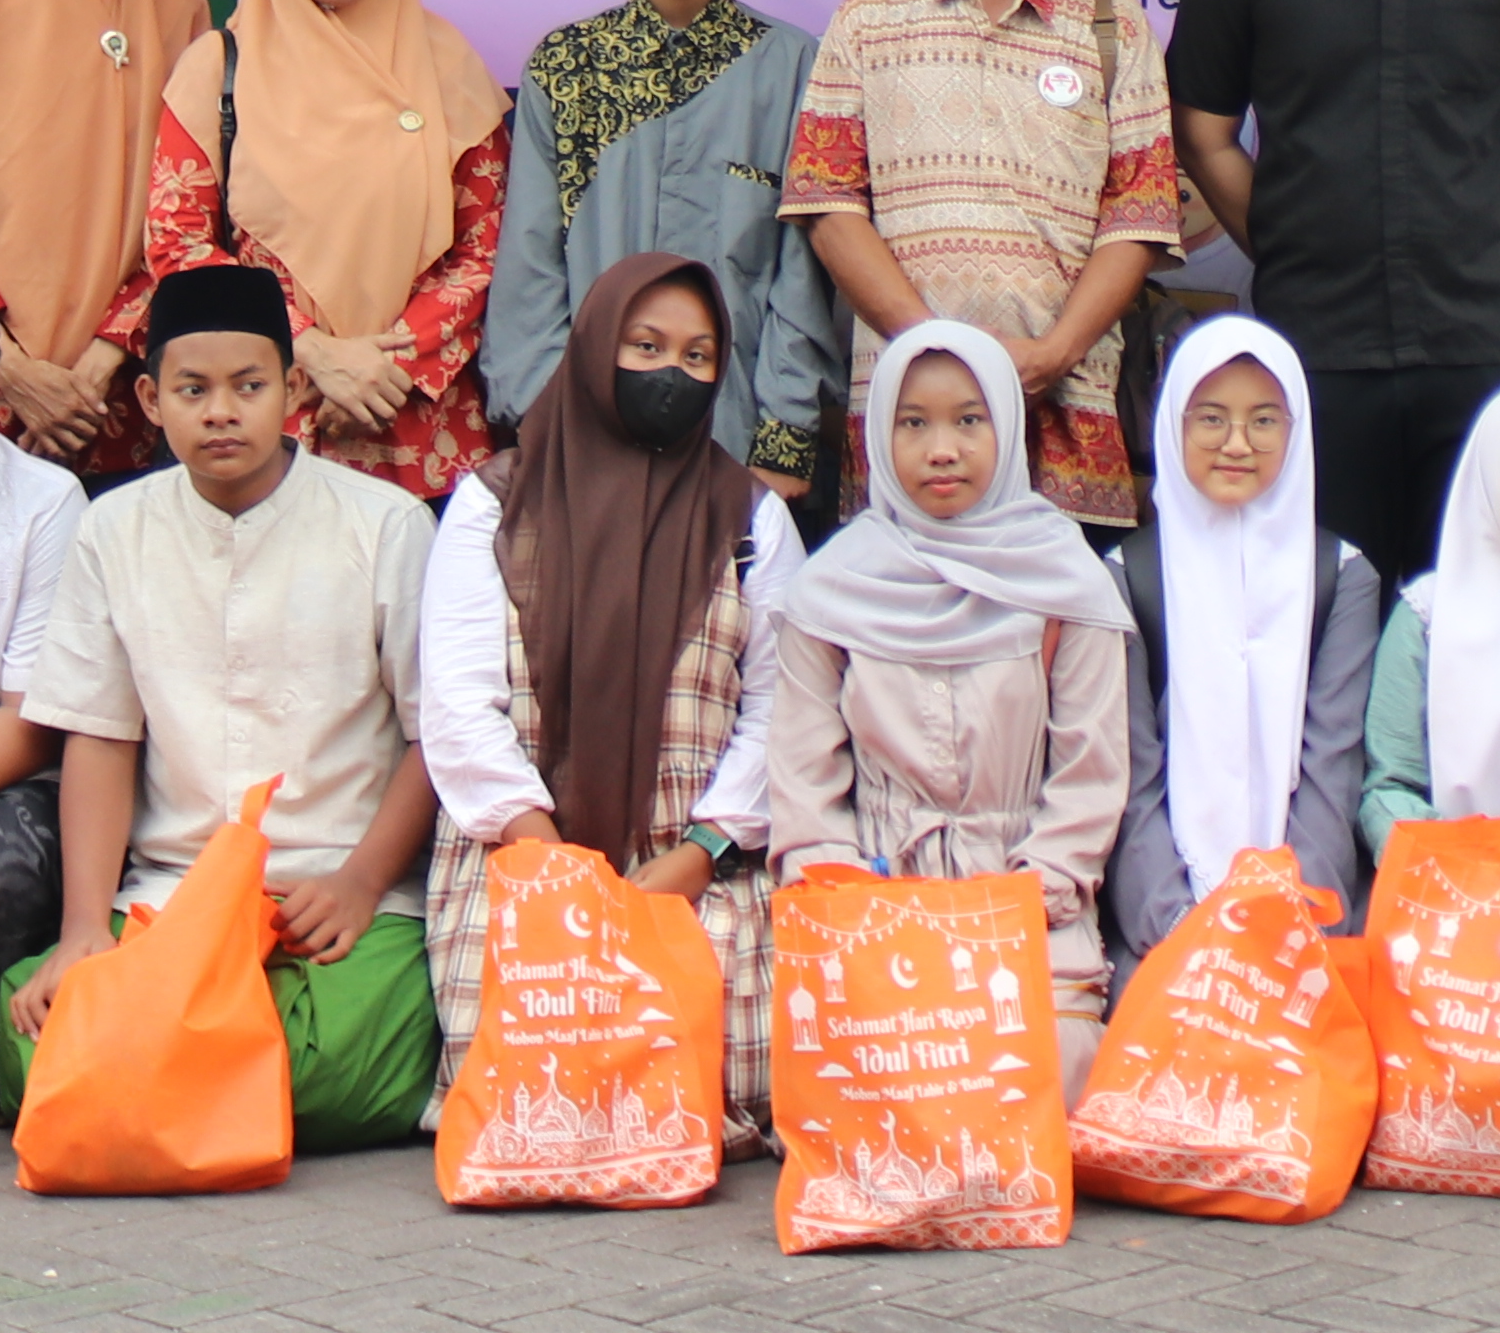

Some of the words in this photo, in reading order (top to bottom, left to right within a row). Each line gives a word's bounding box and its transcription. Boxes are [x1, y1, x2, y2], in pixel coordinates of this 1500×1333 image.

[499, 960, 567, 985] Selamat
[1247, 965, 1287, 1000] Raya
[1419, 966, 1488, 997] Selamat
[519, 986, 575, 1018] Idul
[1216, 980, 1260, 1025] Fitri
[1436, 998, 1491, 1035] Idul
[502, 1031, 544, 1046] Mohon
[827, 1015, 897, 1039] Selamat
[898, 1006, 936, 1036] Hari
[936, 1007, 987, 1030] Raya
[852, 1041, 910, 1075] Idul
[912, 1036, 970, 1070] Fitri
[946, 1080, 958, 1094] &
